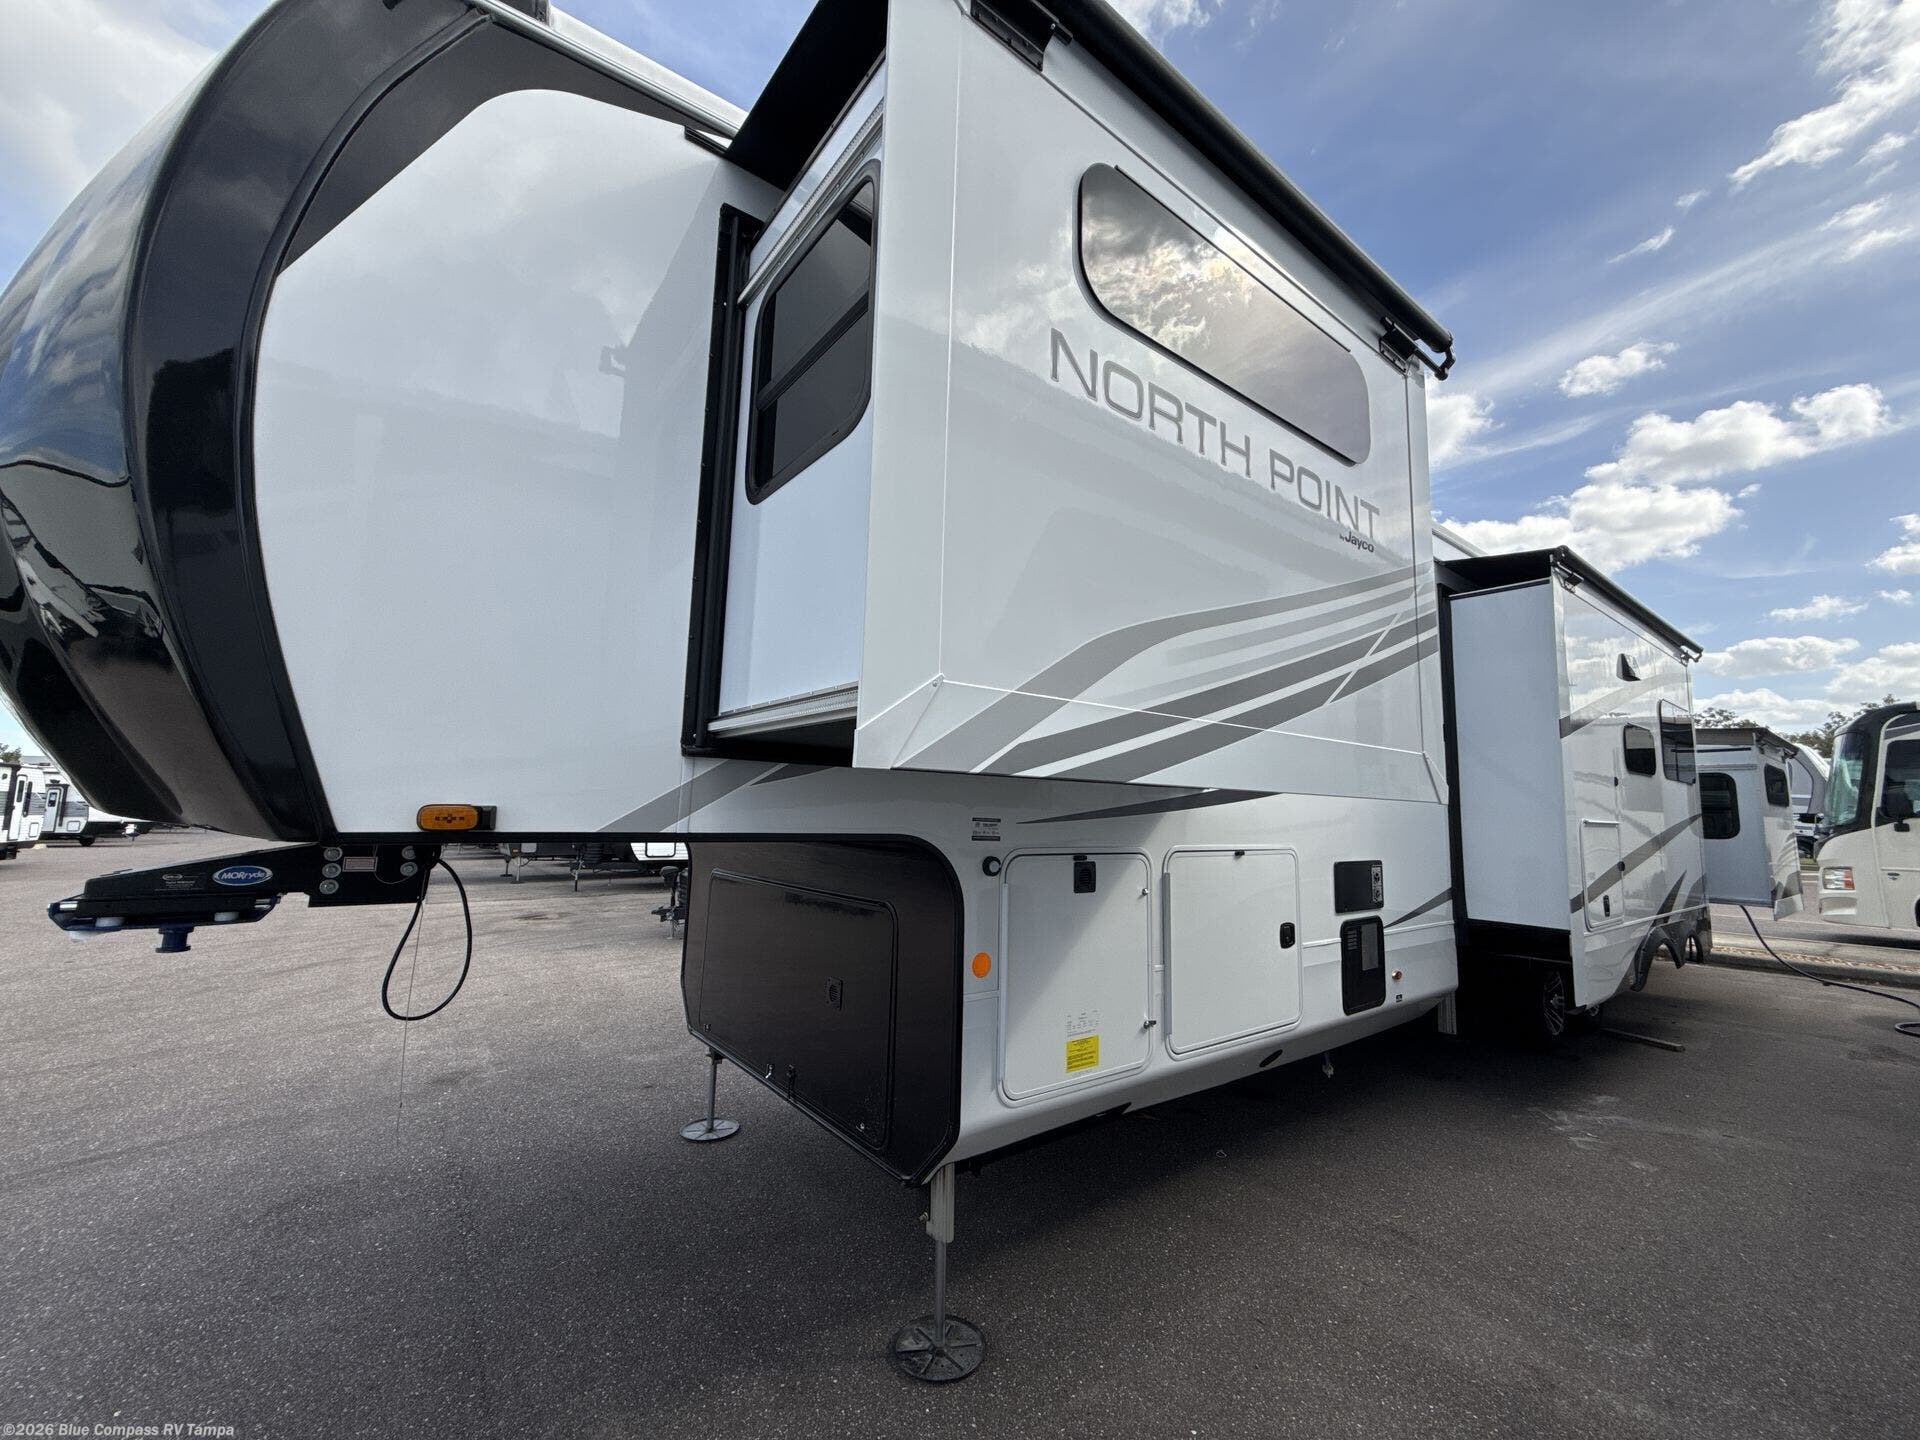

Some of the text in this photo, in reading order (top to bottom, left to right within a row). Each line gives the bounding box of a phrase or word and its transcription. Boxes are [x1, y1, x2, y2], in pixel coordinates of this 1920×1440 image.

[1050, 327, 1380, 539] NORTH POINT
[1344, 531, 1375, 553] Jayco
[221, 870, 266, 881] MORryde
